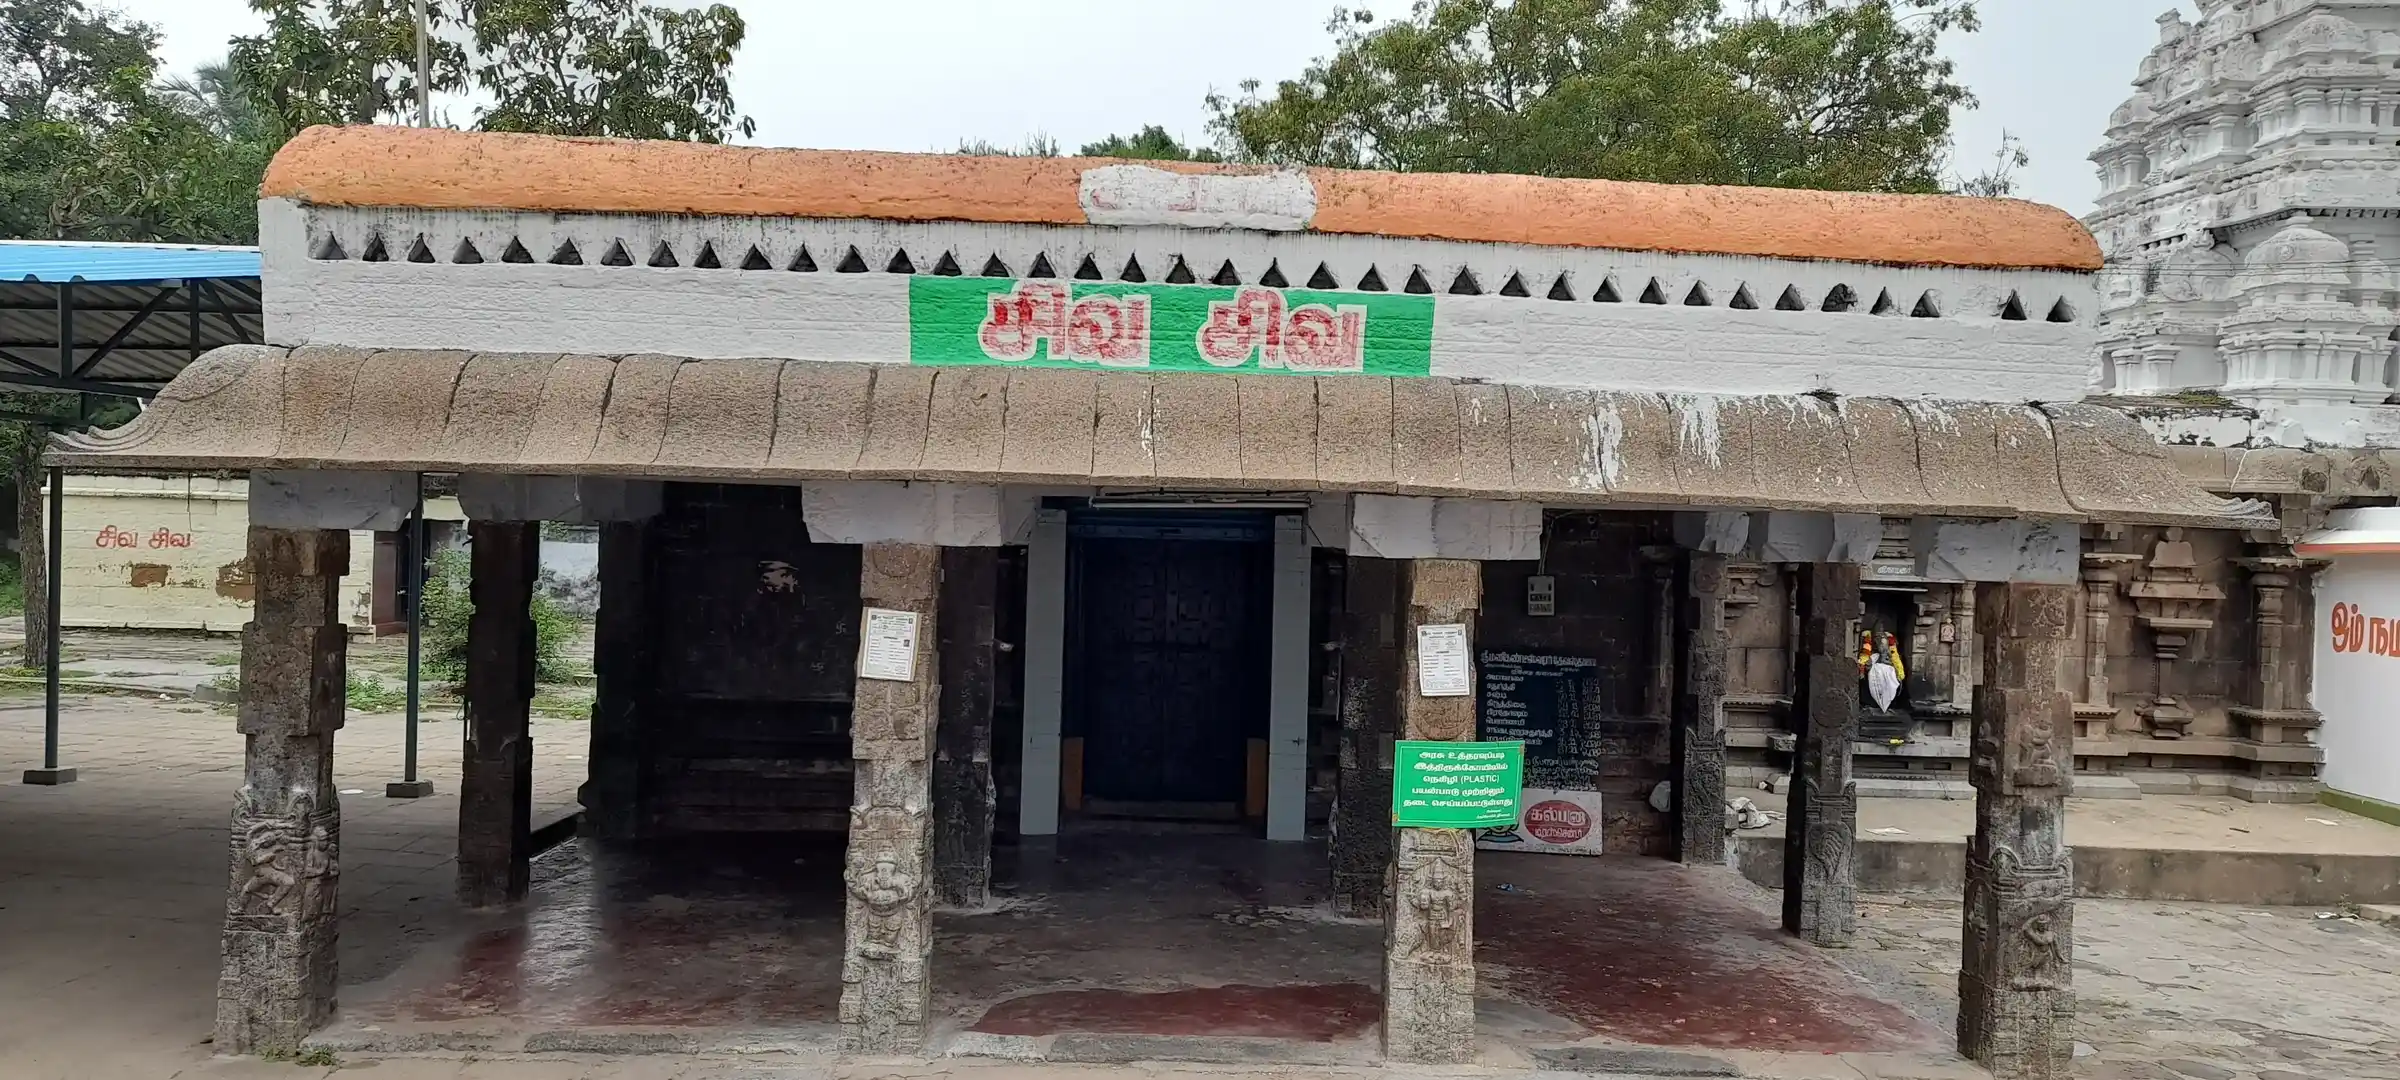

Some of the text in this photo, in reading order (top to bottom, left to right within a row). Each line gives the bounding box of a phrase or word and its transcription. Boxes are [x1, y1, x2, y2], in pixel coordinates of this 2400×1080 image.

[978, 279, 1367, 373] சிவ சிவ
[95, 524, 191, 549] சிவ சிவ
[1419, 751, 1445, 759] அரசு
[1460, 774, 1500, 784] (PLASTIC)
[1411, 787, 1460, 797] பயன்பாடு
[1403, 799, 1429, 807] தடை
